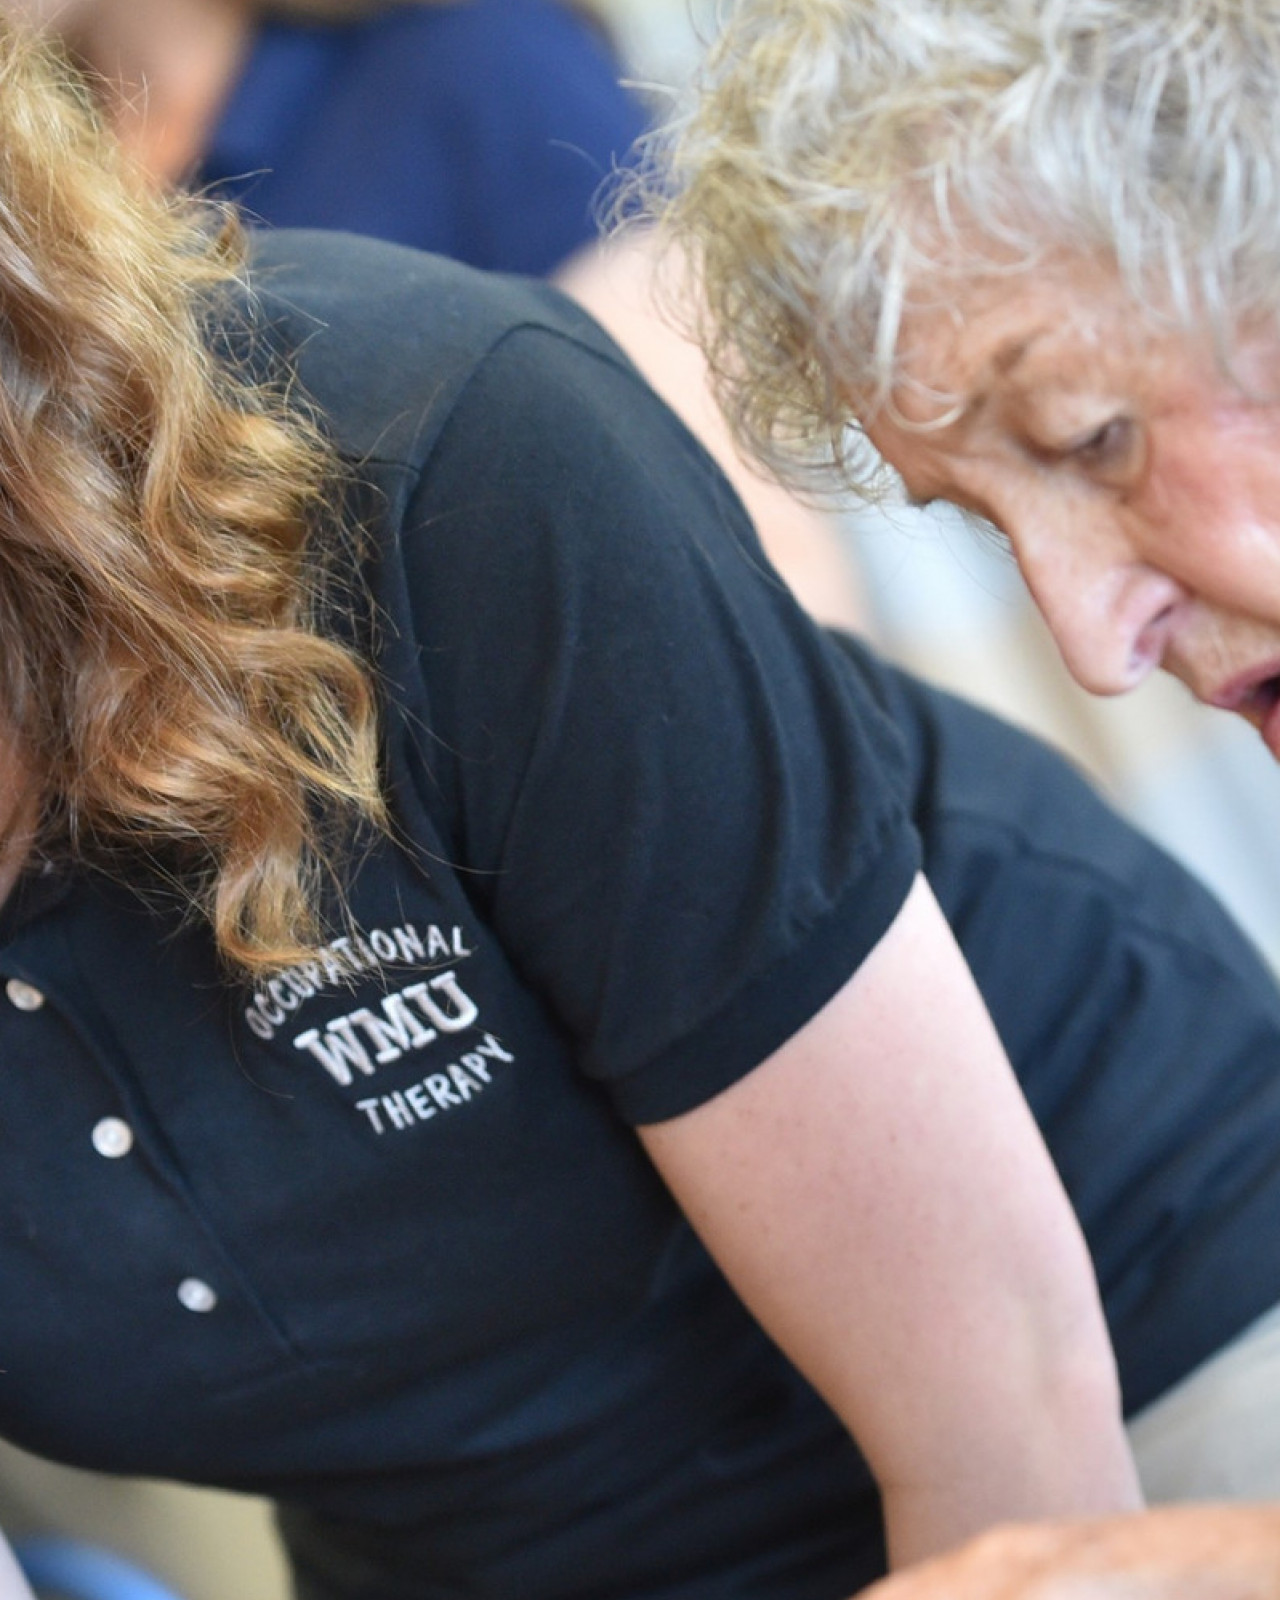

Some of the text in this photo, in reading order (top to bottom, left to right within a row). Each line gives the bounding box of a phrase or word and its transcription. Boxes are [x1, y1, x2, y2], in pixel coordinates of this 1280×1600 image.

[245, 924, 471, 1040] OCCUPATIONAL
[293, 970, 479, 1087] WMU
[355, 1033, 515, 1136] THERAPY
